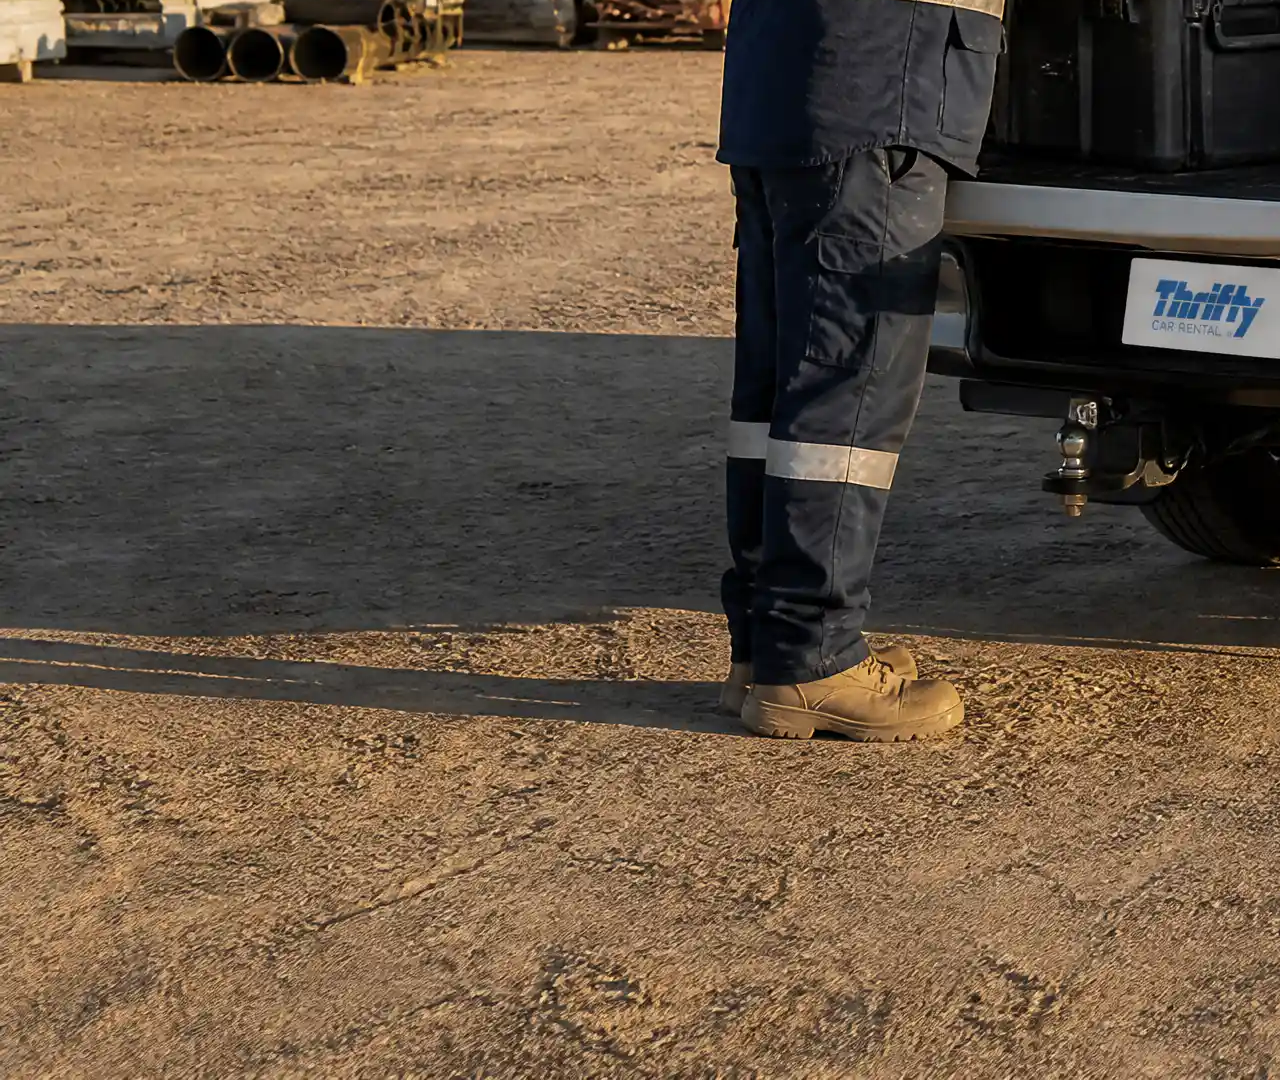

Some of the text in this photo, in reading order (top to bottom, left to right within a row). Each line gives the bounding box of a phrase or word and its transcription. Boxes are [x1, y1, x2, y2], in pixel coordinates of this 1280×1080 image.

[1152, 279, 1266, 338] Thrifty
[1152, 320, 1222, 337] CAR RENTAL
